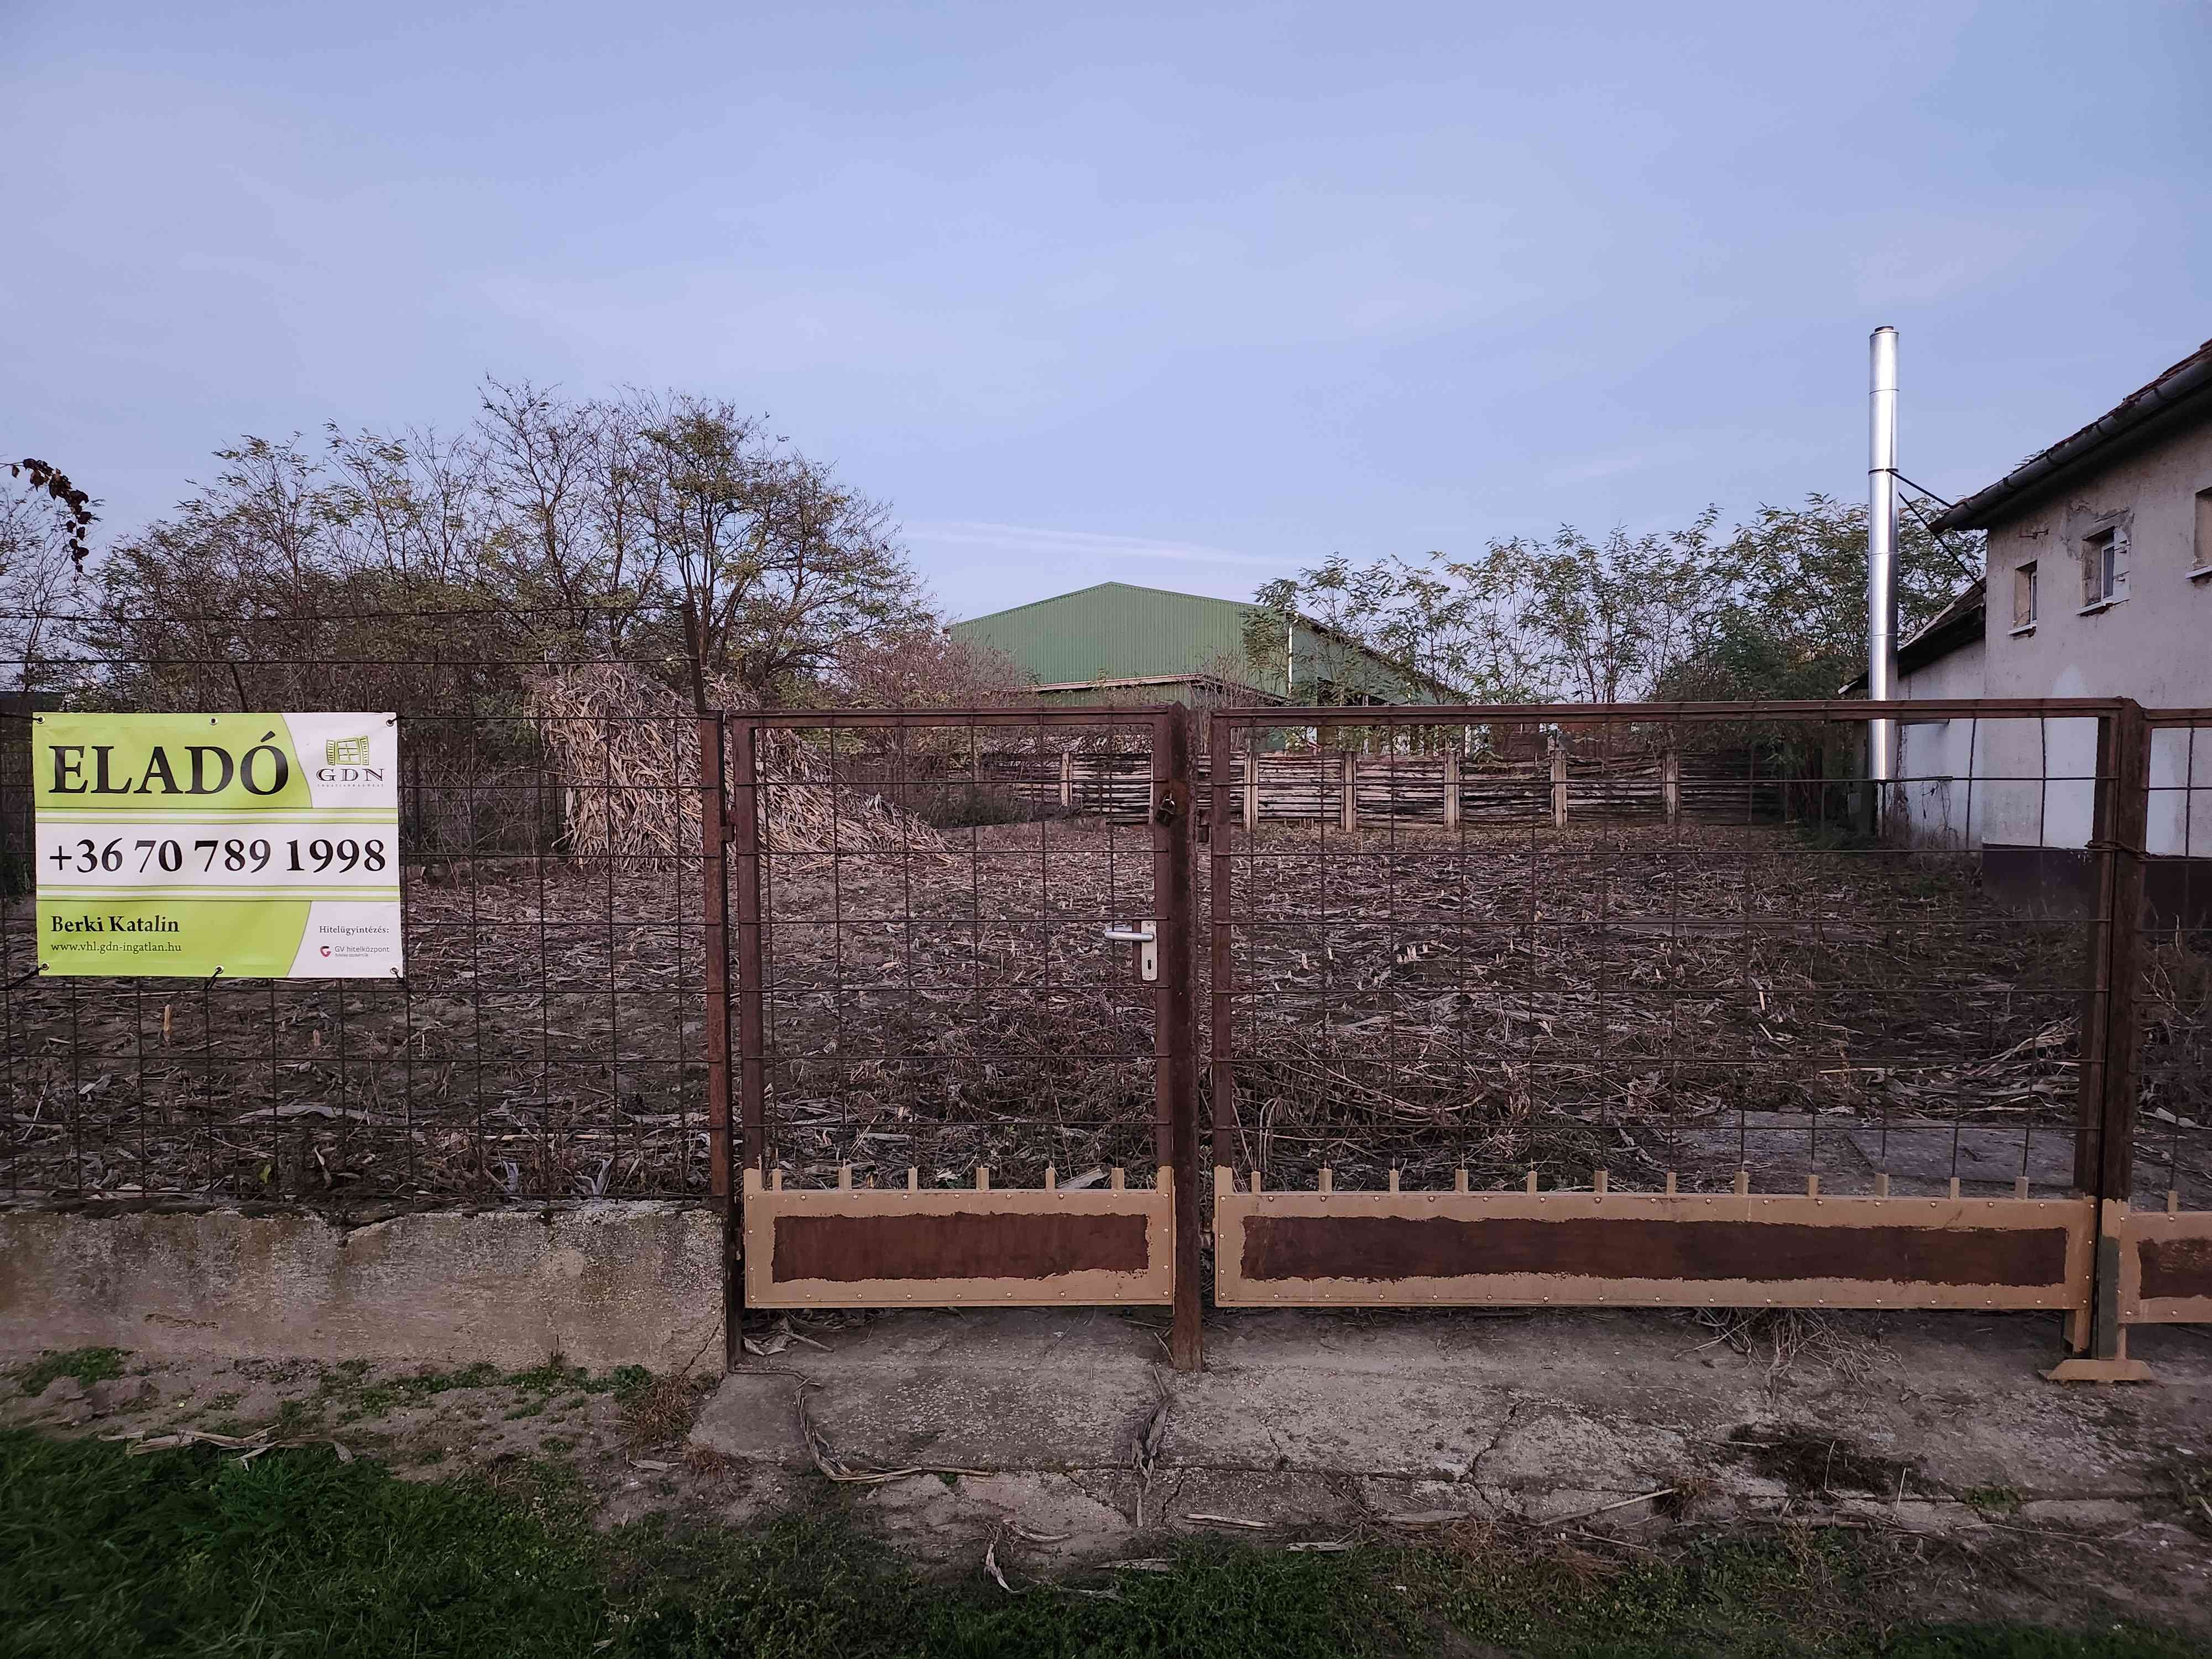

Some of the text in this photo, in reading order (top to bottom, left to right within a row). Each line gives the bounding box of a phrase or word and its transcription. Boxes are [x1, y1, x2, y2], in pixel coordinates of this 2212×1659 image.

[48, 731, 289, 796] ELADÓ
[316, 768, 385, 781] GDN
[49, 837, 386, 874] +36 70 789 1998
[50, 915, 180, 932] Berki Katalin
[319, 925, 390, 936] Hitelügyintézés:
[50, 941, 182, 954] www.vhl.gdn-ingatlan.hu
[346, 946, 390, 954] hitelközpont
